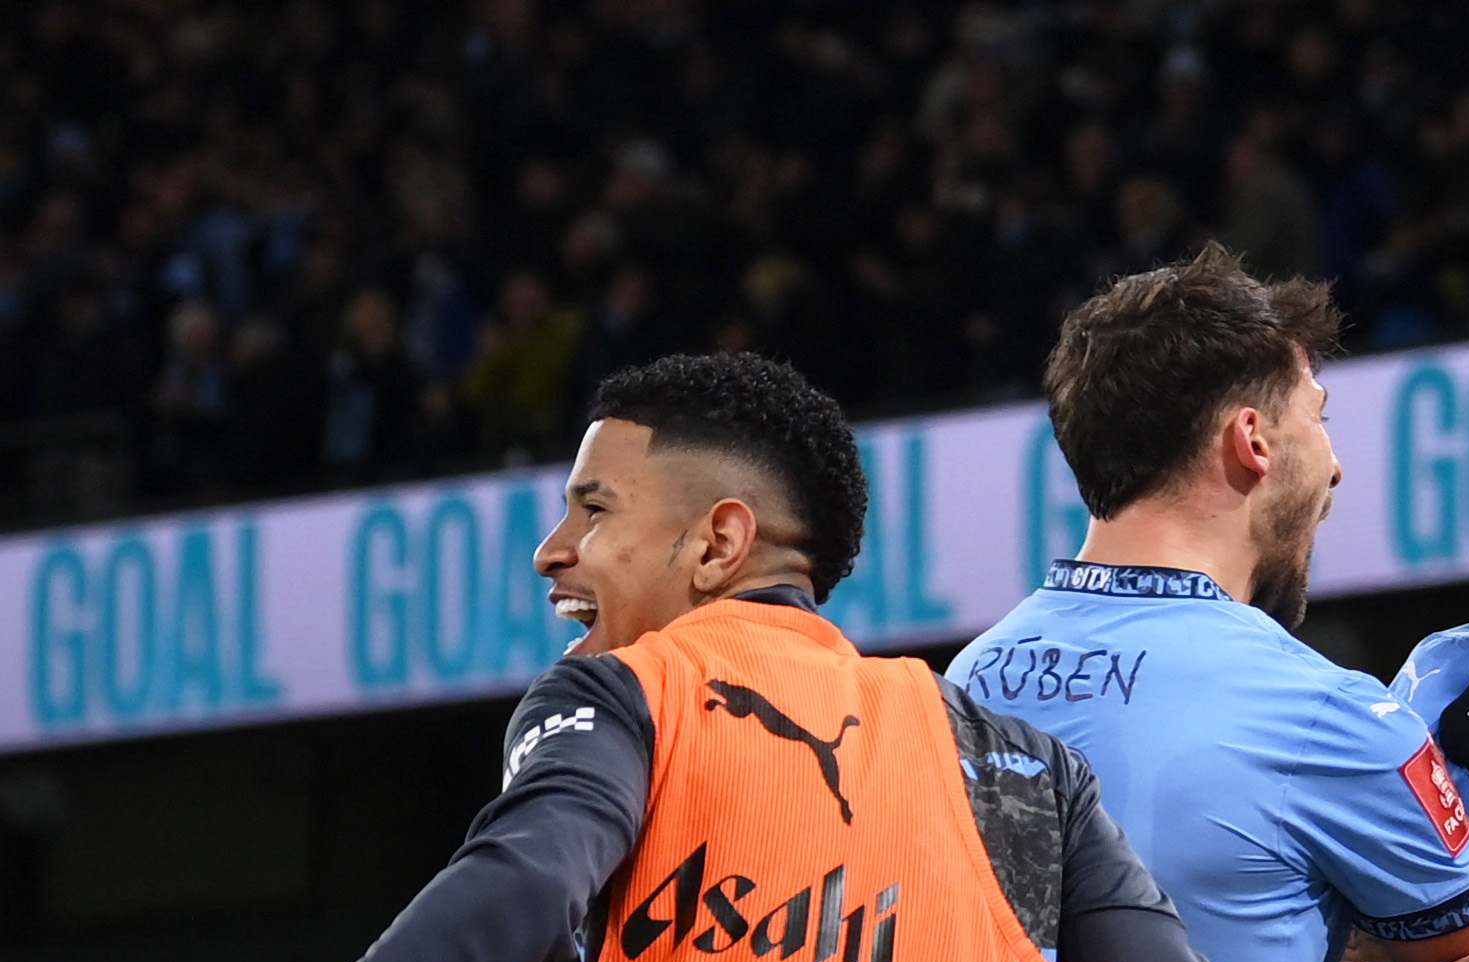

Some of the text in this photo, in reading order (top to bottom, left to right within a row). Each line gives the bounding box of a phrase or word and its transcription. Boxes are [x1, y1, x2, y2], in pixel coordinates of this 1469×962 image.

[32, 518, 284, 730] GOAL
[350, 484, 590, 692] GOA
[1443, 816, 1460, 836] FA
